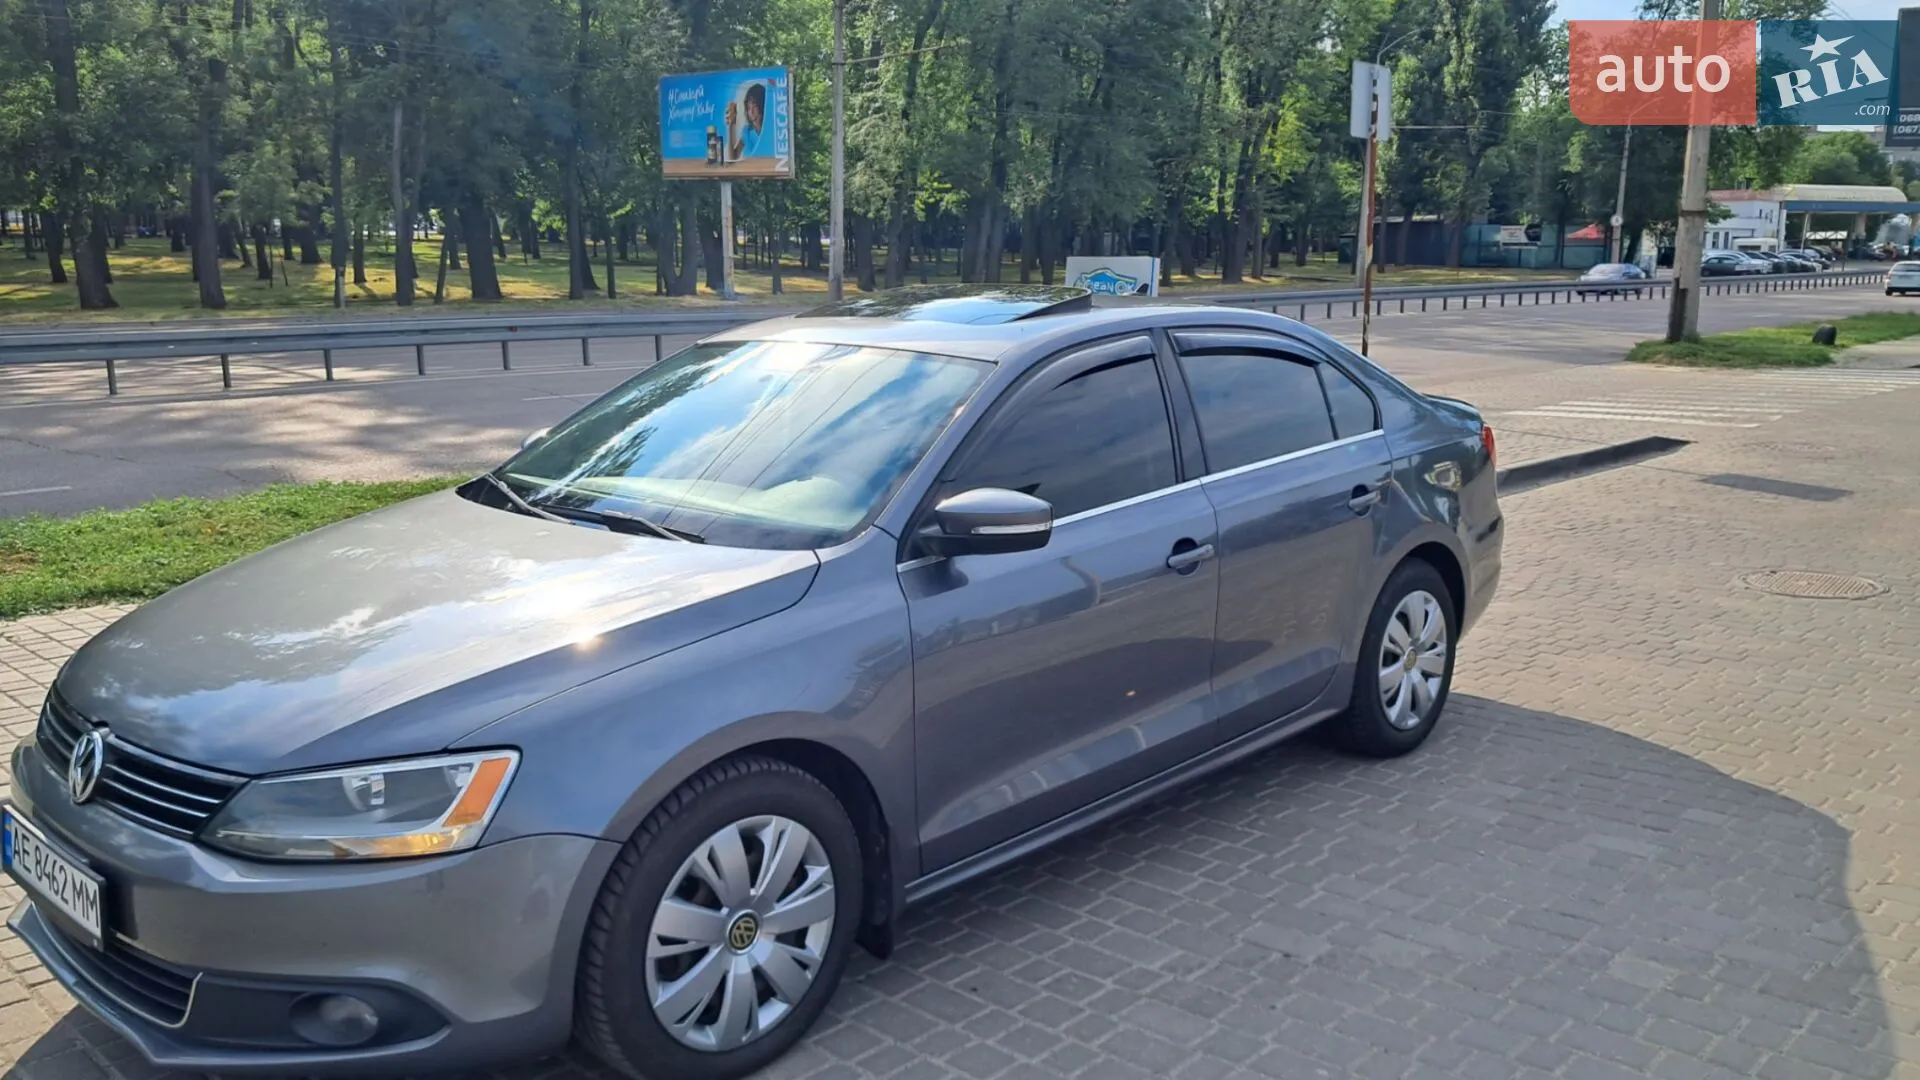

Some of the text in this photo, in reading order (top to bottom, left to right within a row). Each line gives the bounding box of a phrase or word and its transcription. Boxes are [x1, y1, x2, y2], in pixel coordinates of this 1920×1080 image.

[13, 827, 100, 928] AE 8462 MM
